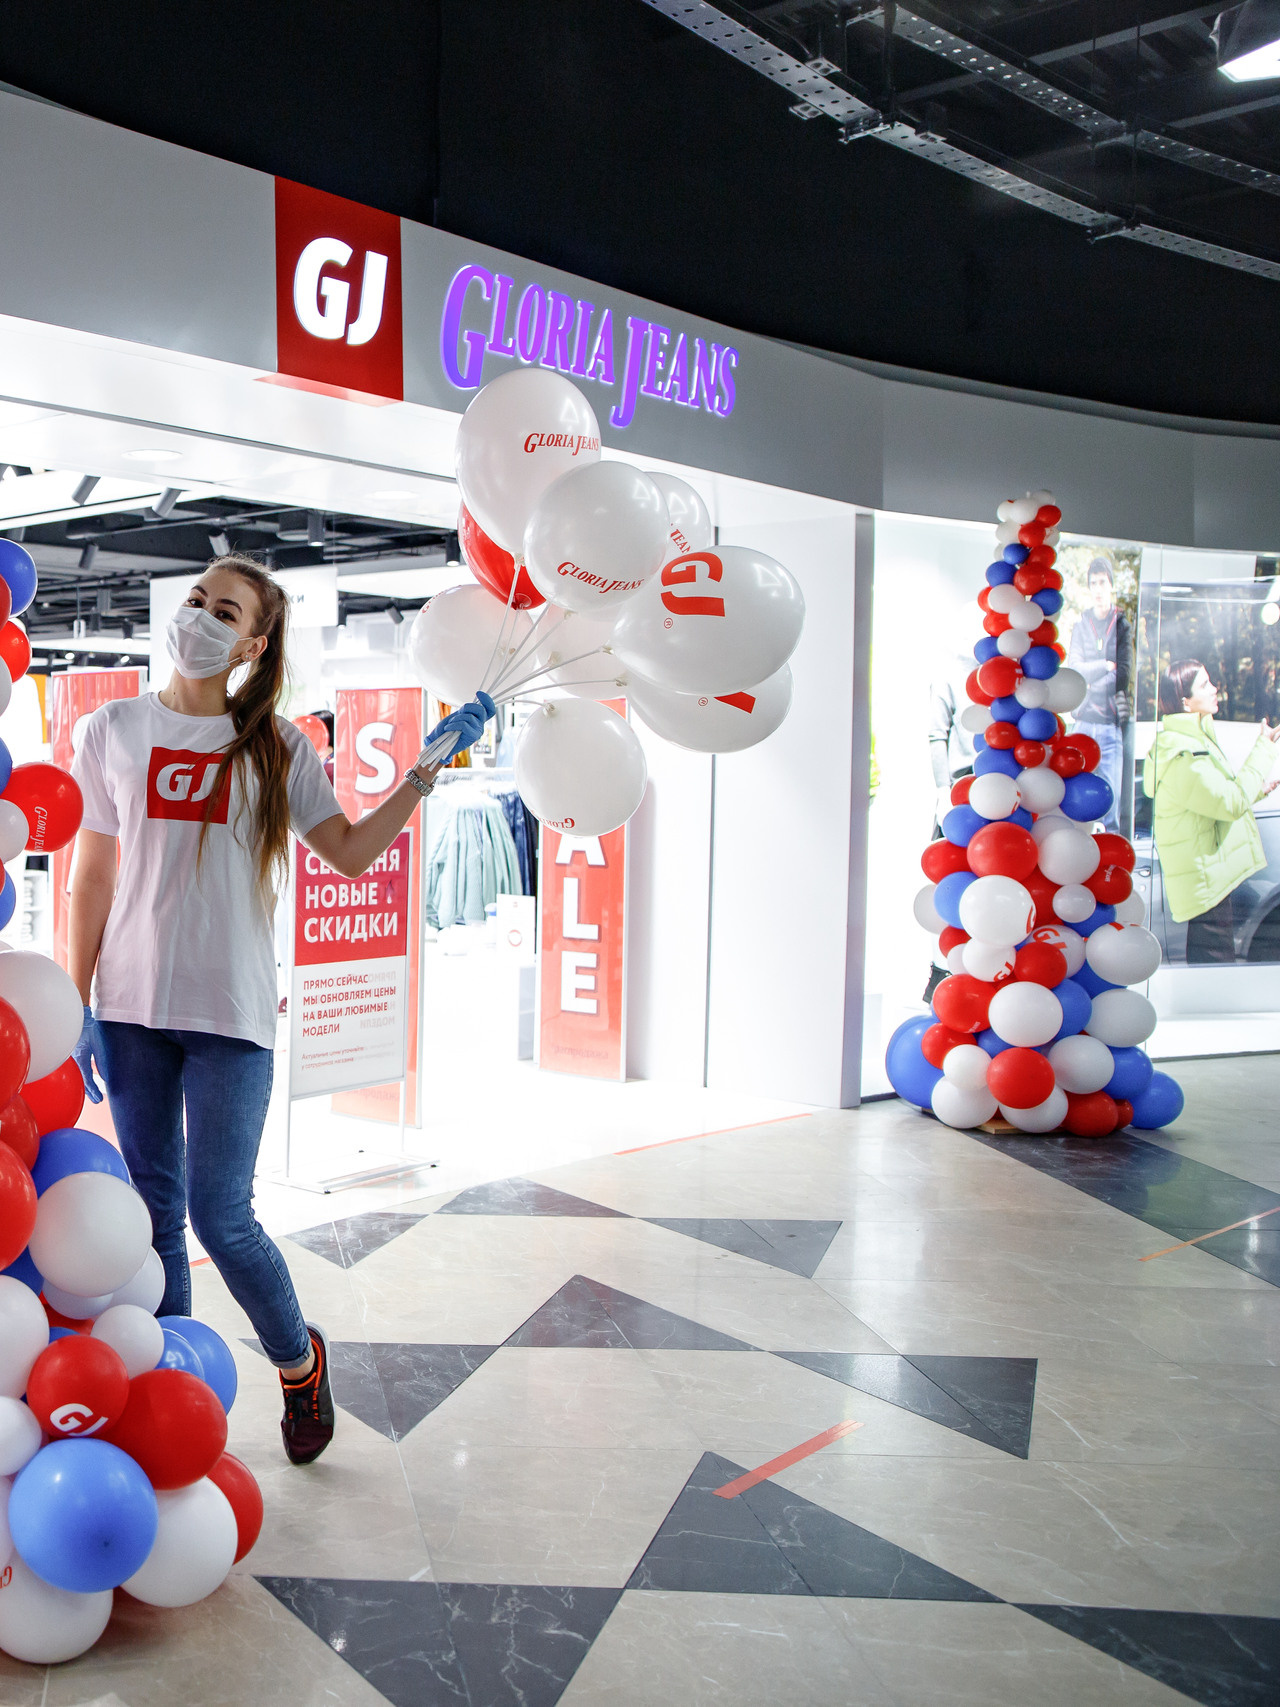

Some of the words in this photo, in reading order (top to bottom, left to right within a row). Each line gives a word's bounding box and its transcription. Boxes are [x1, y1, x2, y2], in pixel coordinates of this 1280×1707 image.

[293, 236, 389, 346] GJ
[439, 264, 615, 390] GLORIA
[610, 316, 740, 428] JEANS
[524, 433, 574, 453] GLORIA
[572, 435, 600, 456] JEANS
[557, 561, 606, 590] GLORIA
[599, 578, 645, 594] JEANS
[661, 551, 726, 617] GJ
[156, 762, 221, 802] GJ
[34, 805, 48, 838] GLORIA
[305, 882, 379, 909] НОВЫЕ
[303, 912, 398, 943] СКИДКИ
[555, 834, 607, 1014] ALE
[303, 978, 334, 991] ПРЯМО
[336, 974, 369, 987] СЕЙЧАС
[303, 996, 318, 1006] МЫ
[320, 989, 372, 1004] ОБНОВЛЯЕМ
[373, 986, 397, 998] ЦЕНЫ
[302, 1011, 315, 1022] НА
[317, 1007, 343, 1020] ВАШИ
[344, 1002, 388, 1016] ЛЮБИМЫЕ
[302, 1023, 340, 1037] МОДЕЛИ
[50, 1403, 109, 1437] GJ
